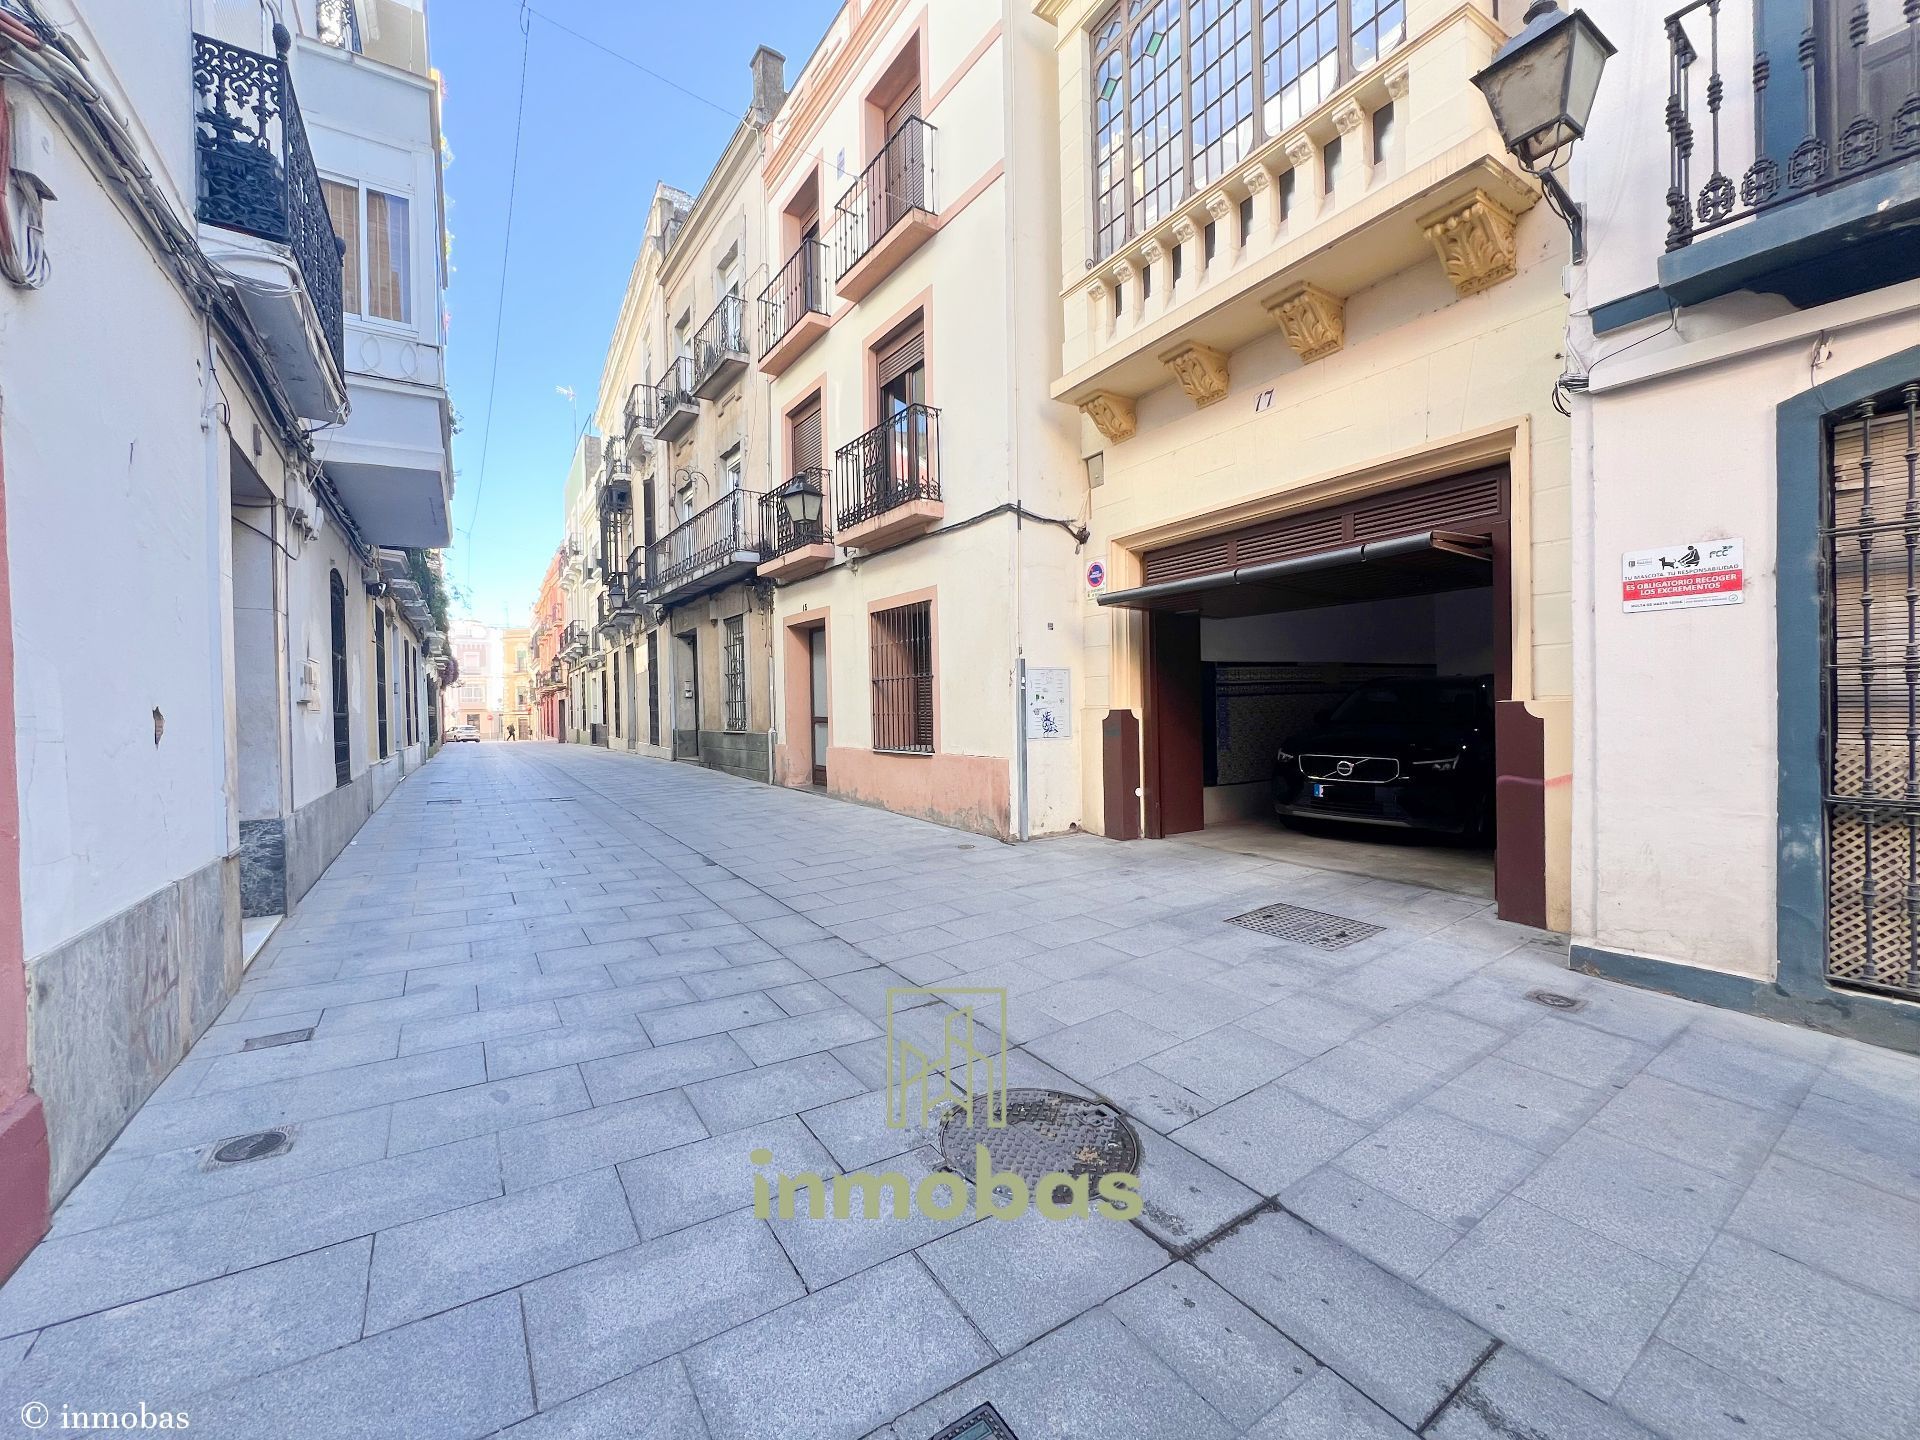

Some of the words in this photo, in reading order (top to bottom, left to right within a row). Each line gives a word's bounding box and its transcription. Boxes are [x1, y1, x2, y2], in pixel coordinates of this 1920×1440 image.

[1255, 388, 1275, 412] 17
[1677, 564, 1739, 575] RESPONSABILIDAD
[1626, 583, 1636, 591] ES
[1637, 578, 1694, 590] OBLIGATORIO
[1695, 573, 1738, 584] RECOGER
[1640, 588, 1656, 596] LOS
[1658, 582, 1721, 594] EXCREMENTOS
